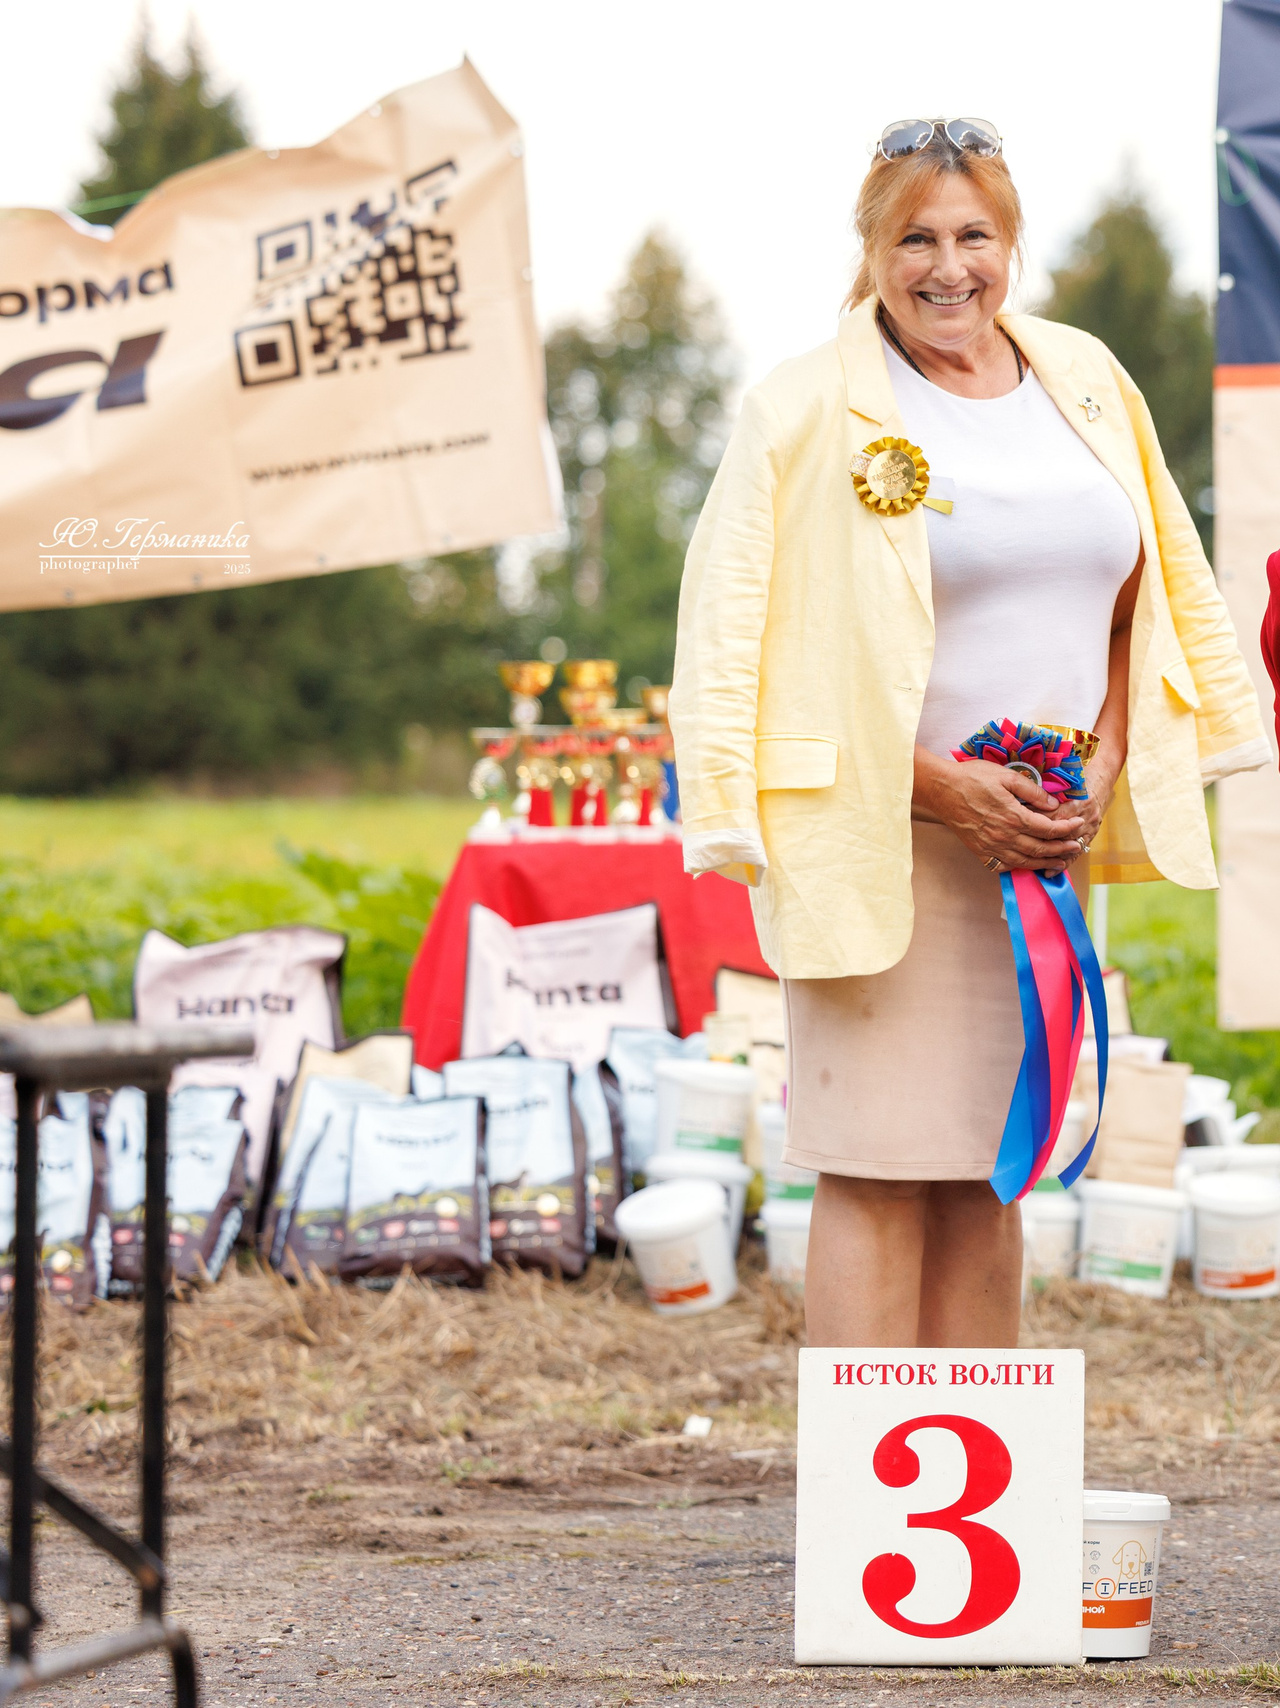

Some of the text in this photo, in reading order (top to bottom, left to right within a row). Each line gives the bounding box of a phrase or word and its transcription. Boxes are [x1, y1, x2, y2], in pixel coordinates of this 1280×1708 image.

[832, 1363, 1055, 1385] ИСТОК ВОЛГИ
[862, 1414, 1021, 1638] 3
